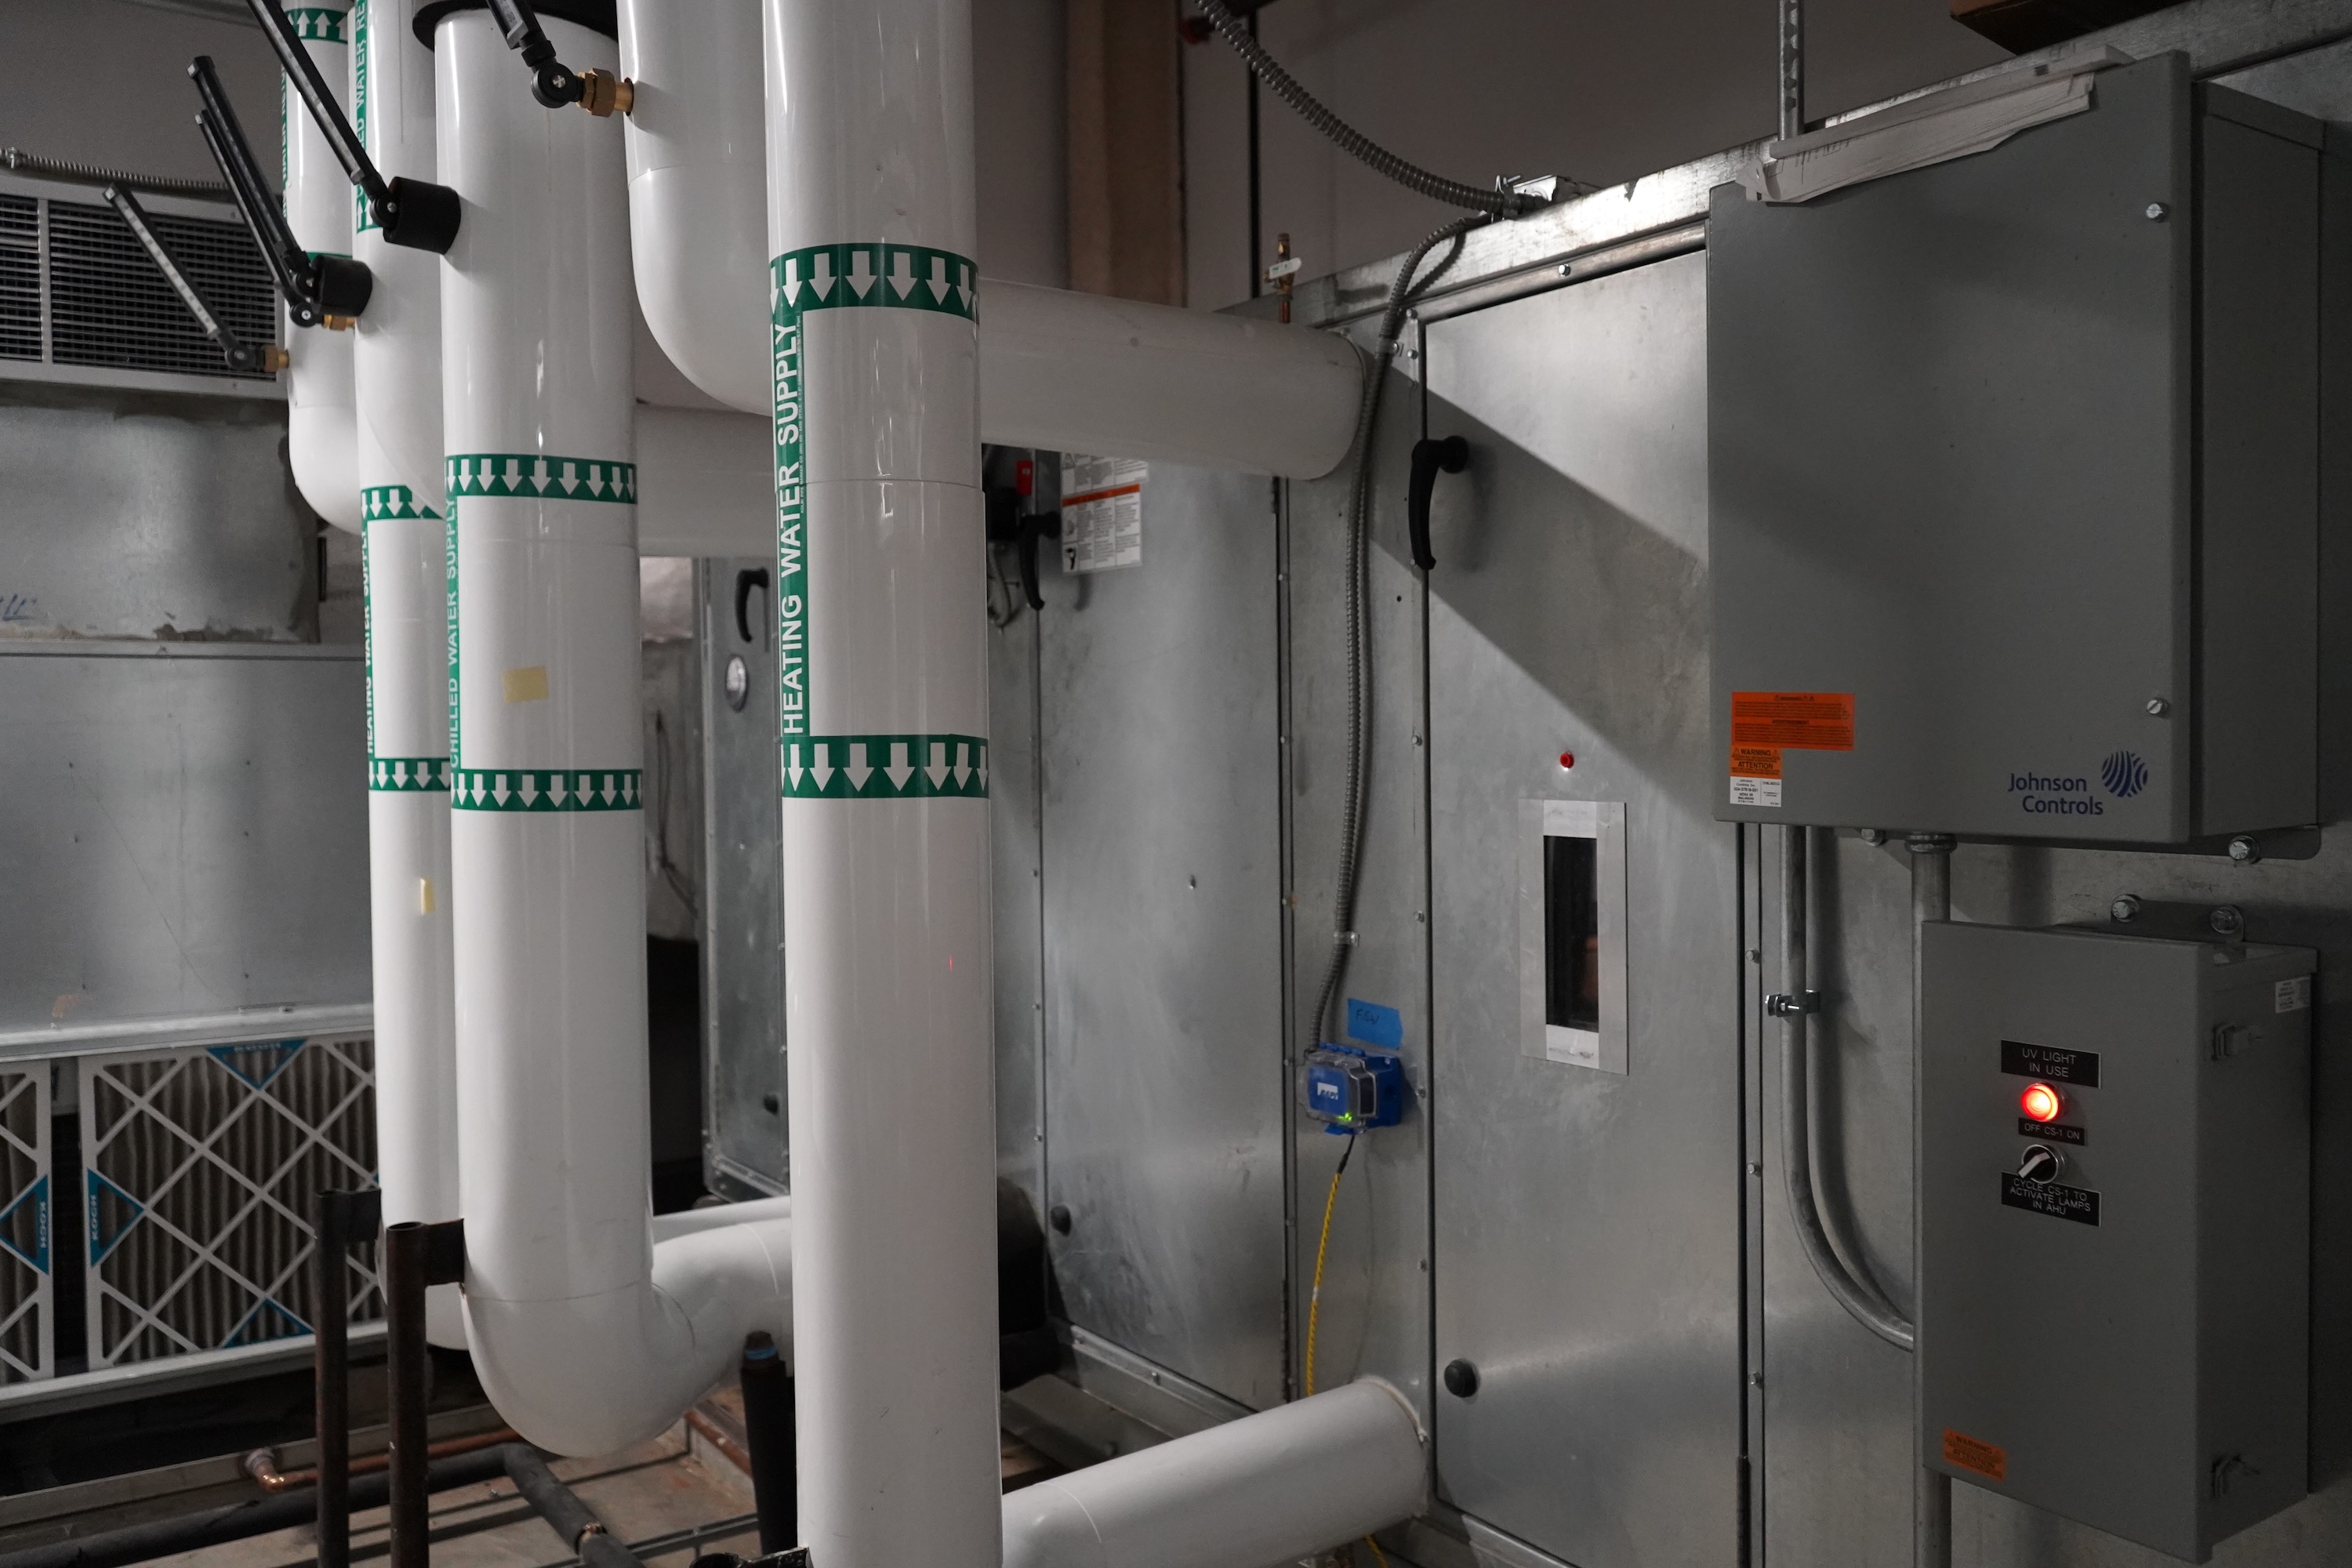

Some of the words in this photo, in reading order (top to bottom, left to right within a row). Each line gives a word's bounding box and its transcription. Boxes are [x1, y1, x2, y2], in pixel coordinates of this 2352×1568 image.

[356, 39, 365, 109] WATER
[774, 322, 799, 446] SUPPLY
[779, 463, 801, 579] WATER
[445, 498, 456, 579] SUPPLY
[447, 591, 458, 666] WATER
[782, 593, 804, 735] HEATING
[448, 678, 459, 769] CHILLED
[2007, 772, 2088, 793] Johnson
[2022, 795, 2104, 816] Controls
[2022, 1047, 2038, 1058] UV
[2042, 1051, 2077, 1065] LIGHT
[2029, 1062, 2041, 1073] IN
[2045, 1065, 2070, 1078] USE
[2024, 1123, 2041, 1133] OFF
[2044, 1126, 2063, 1137] CS-1
[2067, 1130, 2080, 1140] ON
[2009, 1186, 2054, 1204] ACTIVATE
[2059, 1195, 2092, 1212] LAMPS
[2013, 1178, 2043, 1192] CYCLE
[2048, 1185, 2069, 1198] CS-1
[2074, 1190, 2088, 1202] TO
[2033, 1200, 2042, 1210] IN
[2045, 1203, 2067, 1216] AHU
